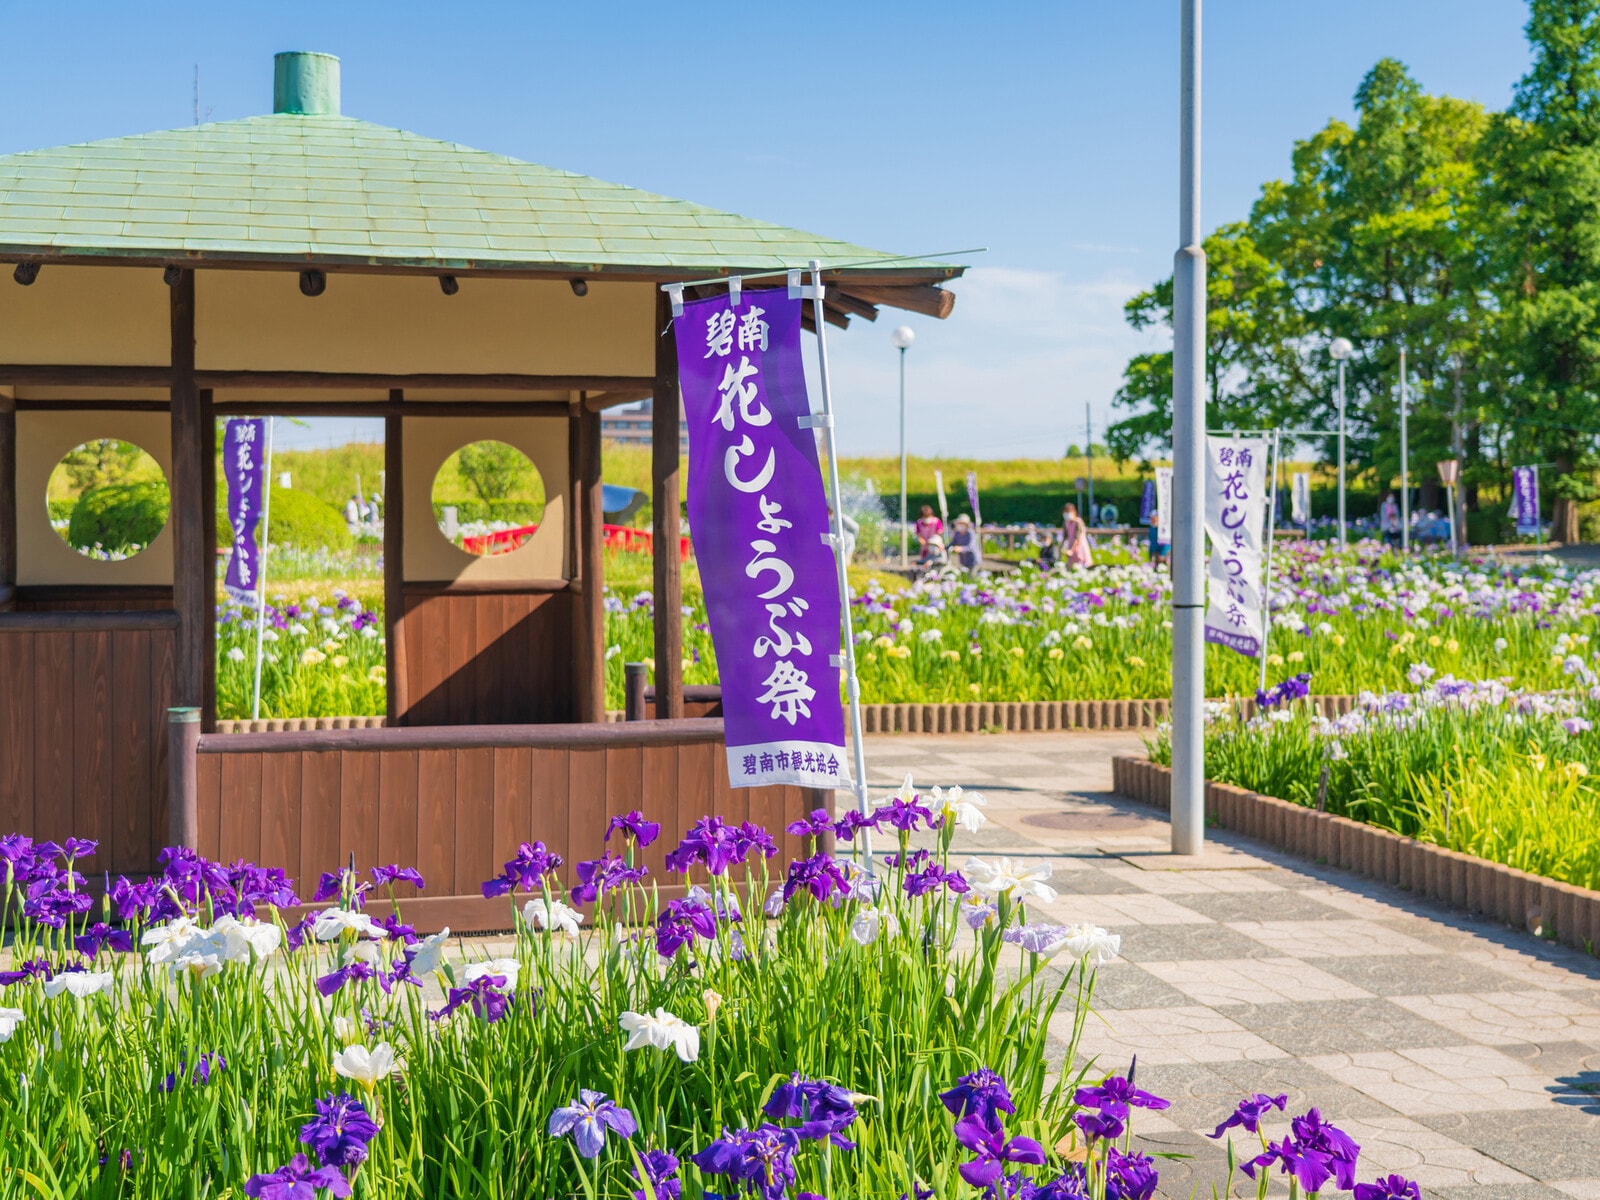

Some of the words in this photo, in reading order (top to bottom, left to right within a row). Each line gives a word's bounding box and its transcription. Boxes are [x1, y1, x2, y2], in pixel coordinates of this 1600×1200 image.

[704, 305, 770, 359] 碧南
[1219, 446, 1253, 468] 碧南
[711, 355, 817, 726] 花しょうぶ祭
[742, 749, 840, 776] 碧南市観光協会
